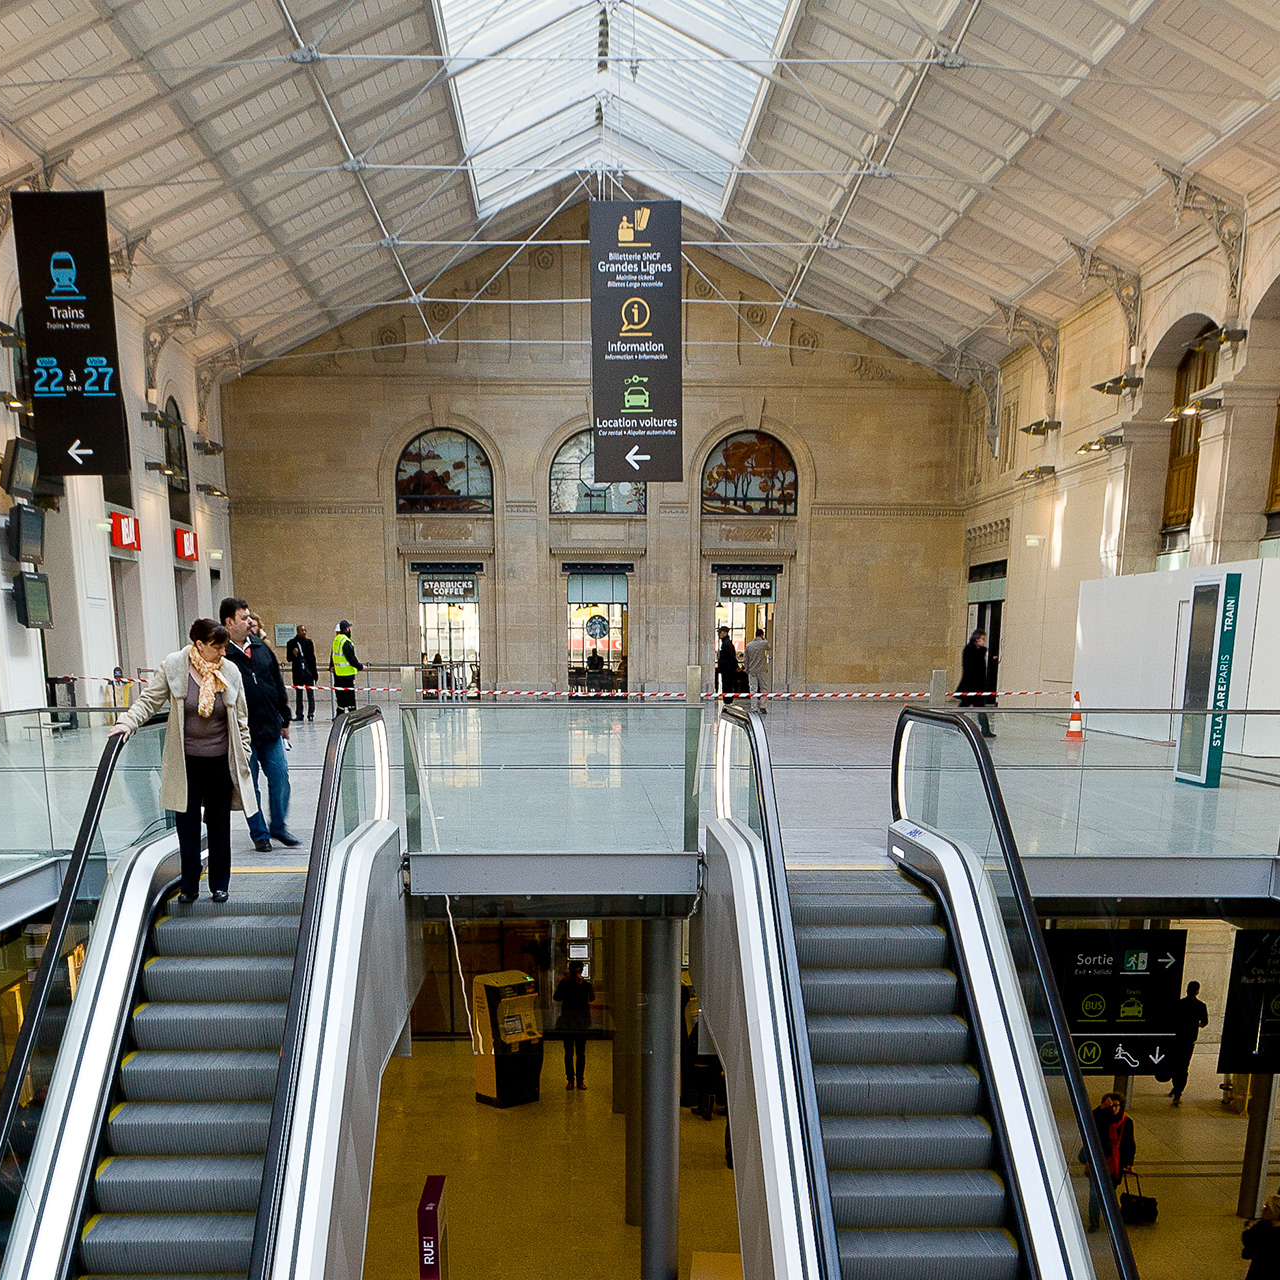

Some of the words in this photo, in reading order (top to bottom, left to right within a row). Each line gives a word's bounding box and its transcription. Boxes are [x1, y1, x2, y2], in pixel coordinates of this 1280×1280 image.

[608, 252, 641, 261] Billetterie
[642, 252, 661, 261] SNCF
[598, 261, 639, 272] Grandes
[640, 261, 672, 274] Lignes
[49, 306, 85, 319] Trains
[608, 341, 664, 352] Information
[33, 367, 65, 392] 22
[69, 369, 77, 382] à
[83, 367, 114, 391] 27
[596, 417, 637, 428] Location
[639, 417, 677, 428] voitures
[423, 581, 473, 589] STARBUCKS
[721, 581, 771, 589] STARBUCKS
[730, 588, 762, 596] COFFEE
[1076, 953, 1114, 966] Sortie
[1241, 976, 1255, 984] Rue
[1085, 1001, 1103, 1010] BUS
[1083, 1046, 1096, 1059] M
